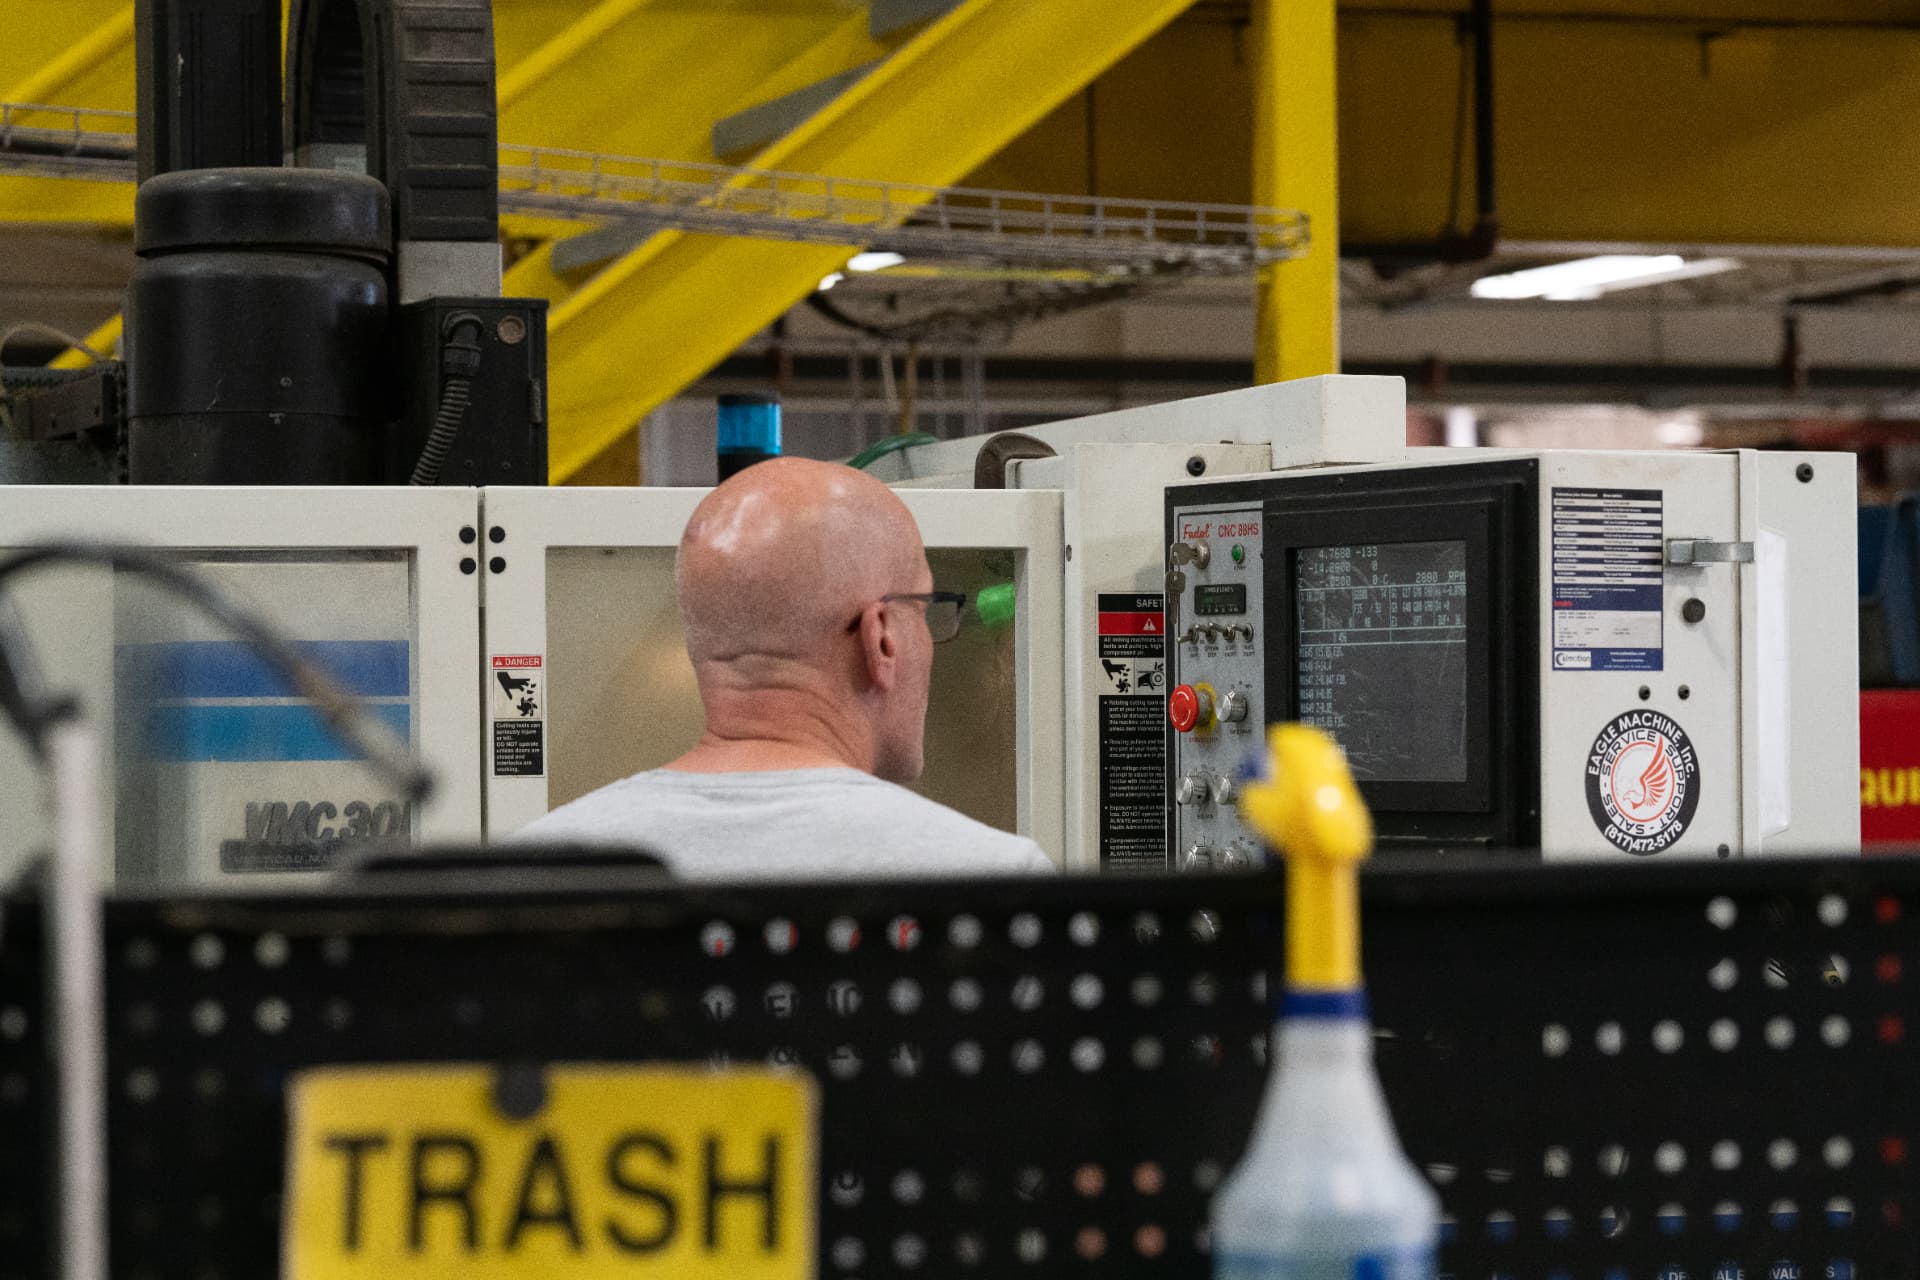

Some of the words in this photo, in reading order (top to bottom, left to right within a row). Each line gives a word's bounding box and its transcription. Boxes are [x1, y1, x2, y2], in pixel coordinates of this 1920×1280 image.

[1218, 524, 1237, 538] CNC
[1238, 522, 1259, 537] 88HS
[1297, 552, 1304, 560] X
[1355, 546, 1378, 558] -133
[1298, 564, 1304, 574] Y
[1449, 570, 1466, 582] RPM
[1136, 599, 1164, 608] SAFET
[505, 657, 540, 666] DANGER
[1588, 725, 1618, 775] EAGLE
[1618, 713, 1682, 747] MACHINE,
[1681, 746, 1695, 778] Inc.
[1602, 730, 1656, 776] SERVICE
[1660, 744, 1685, 829] SUPPORT
[1603, 794, 1645, 834] SALES
[1604, 820, 1682, 852] (817)472-5178
[322, 1132, 781, 1257] TRASH
